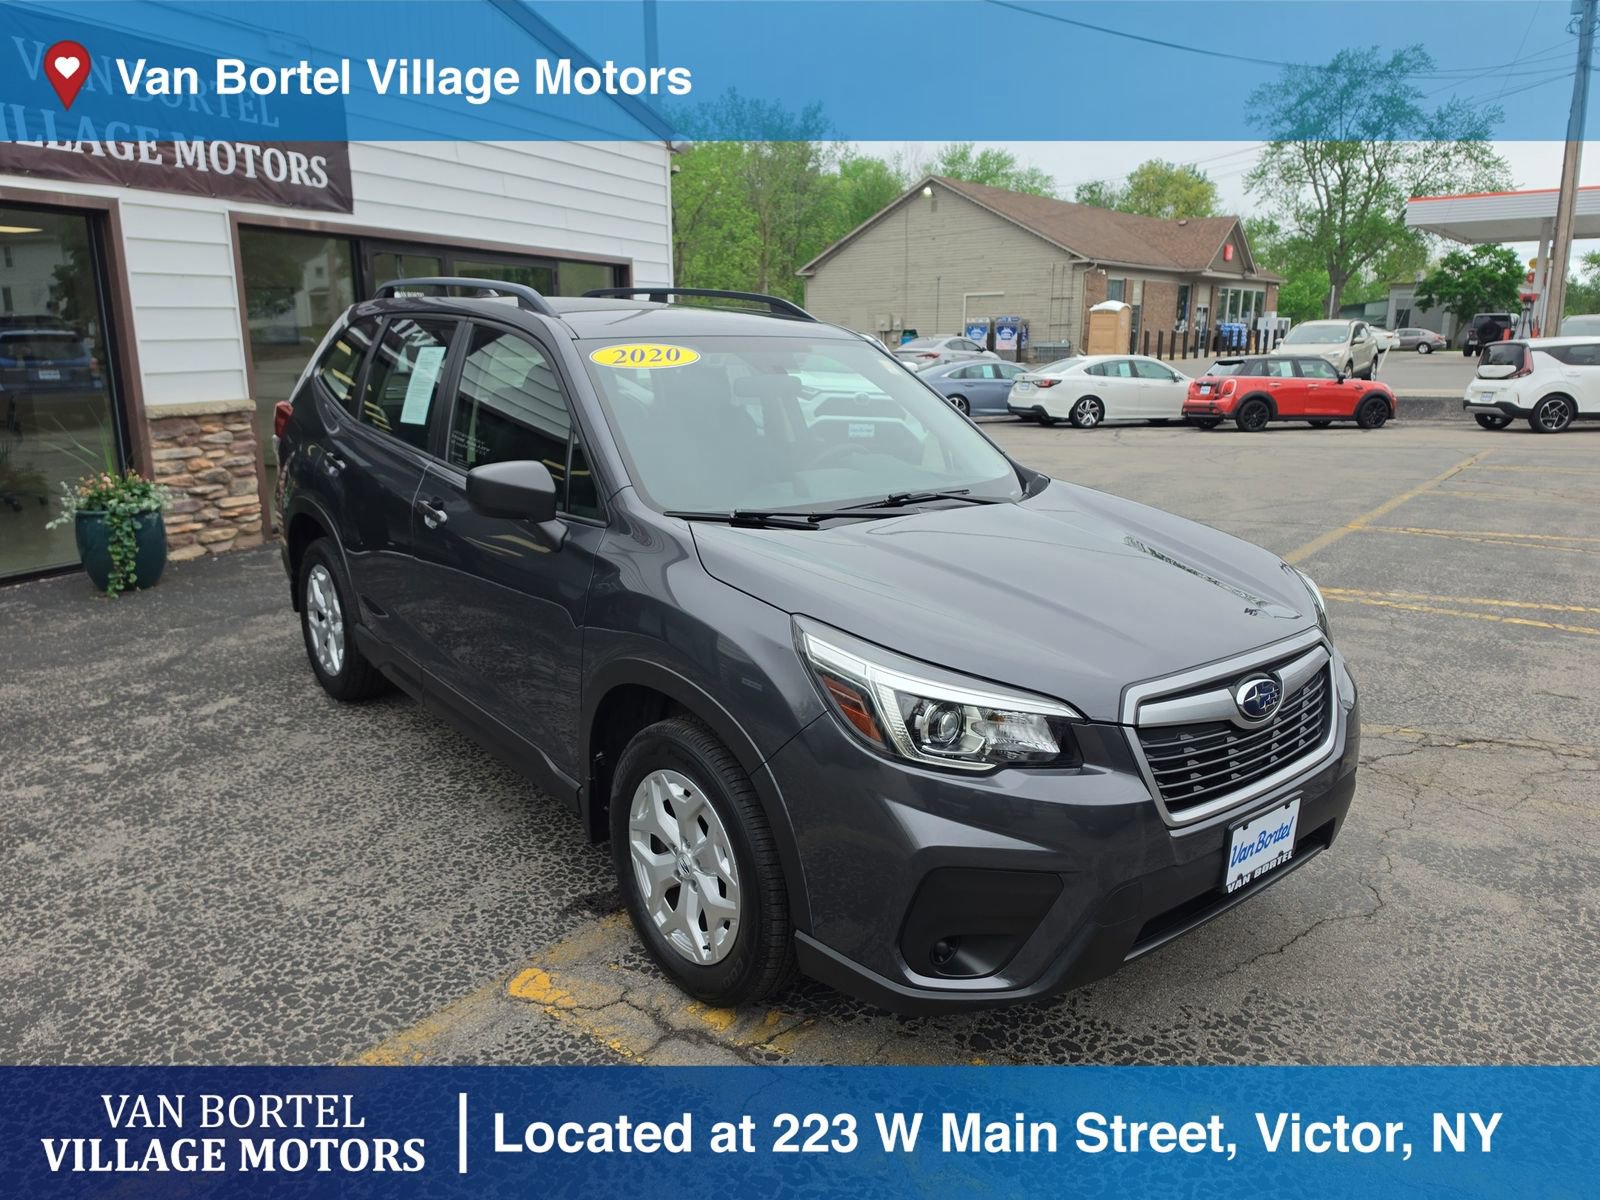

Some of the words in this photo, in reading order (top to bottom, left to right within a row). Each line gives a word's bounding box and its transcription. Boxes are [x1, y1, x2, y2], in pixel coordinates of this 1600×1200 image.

[11, 35, 114, 96] VN
[0, 102, 163, 166] ILLAGE
[174, 131, 329, 189] MOTORS
[612, 347, 681, 365] 2020
[1227, 873, 1251, 894] VAN
[1254, 850, 1294, 879] BORTEL
